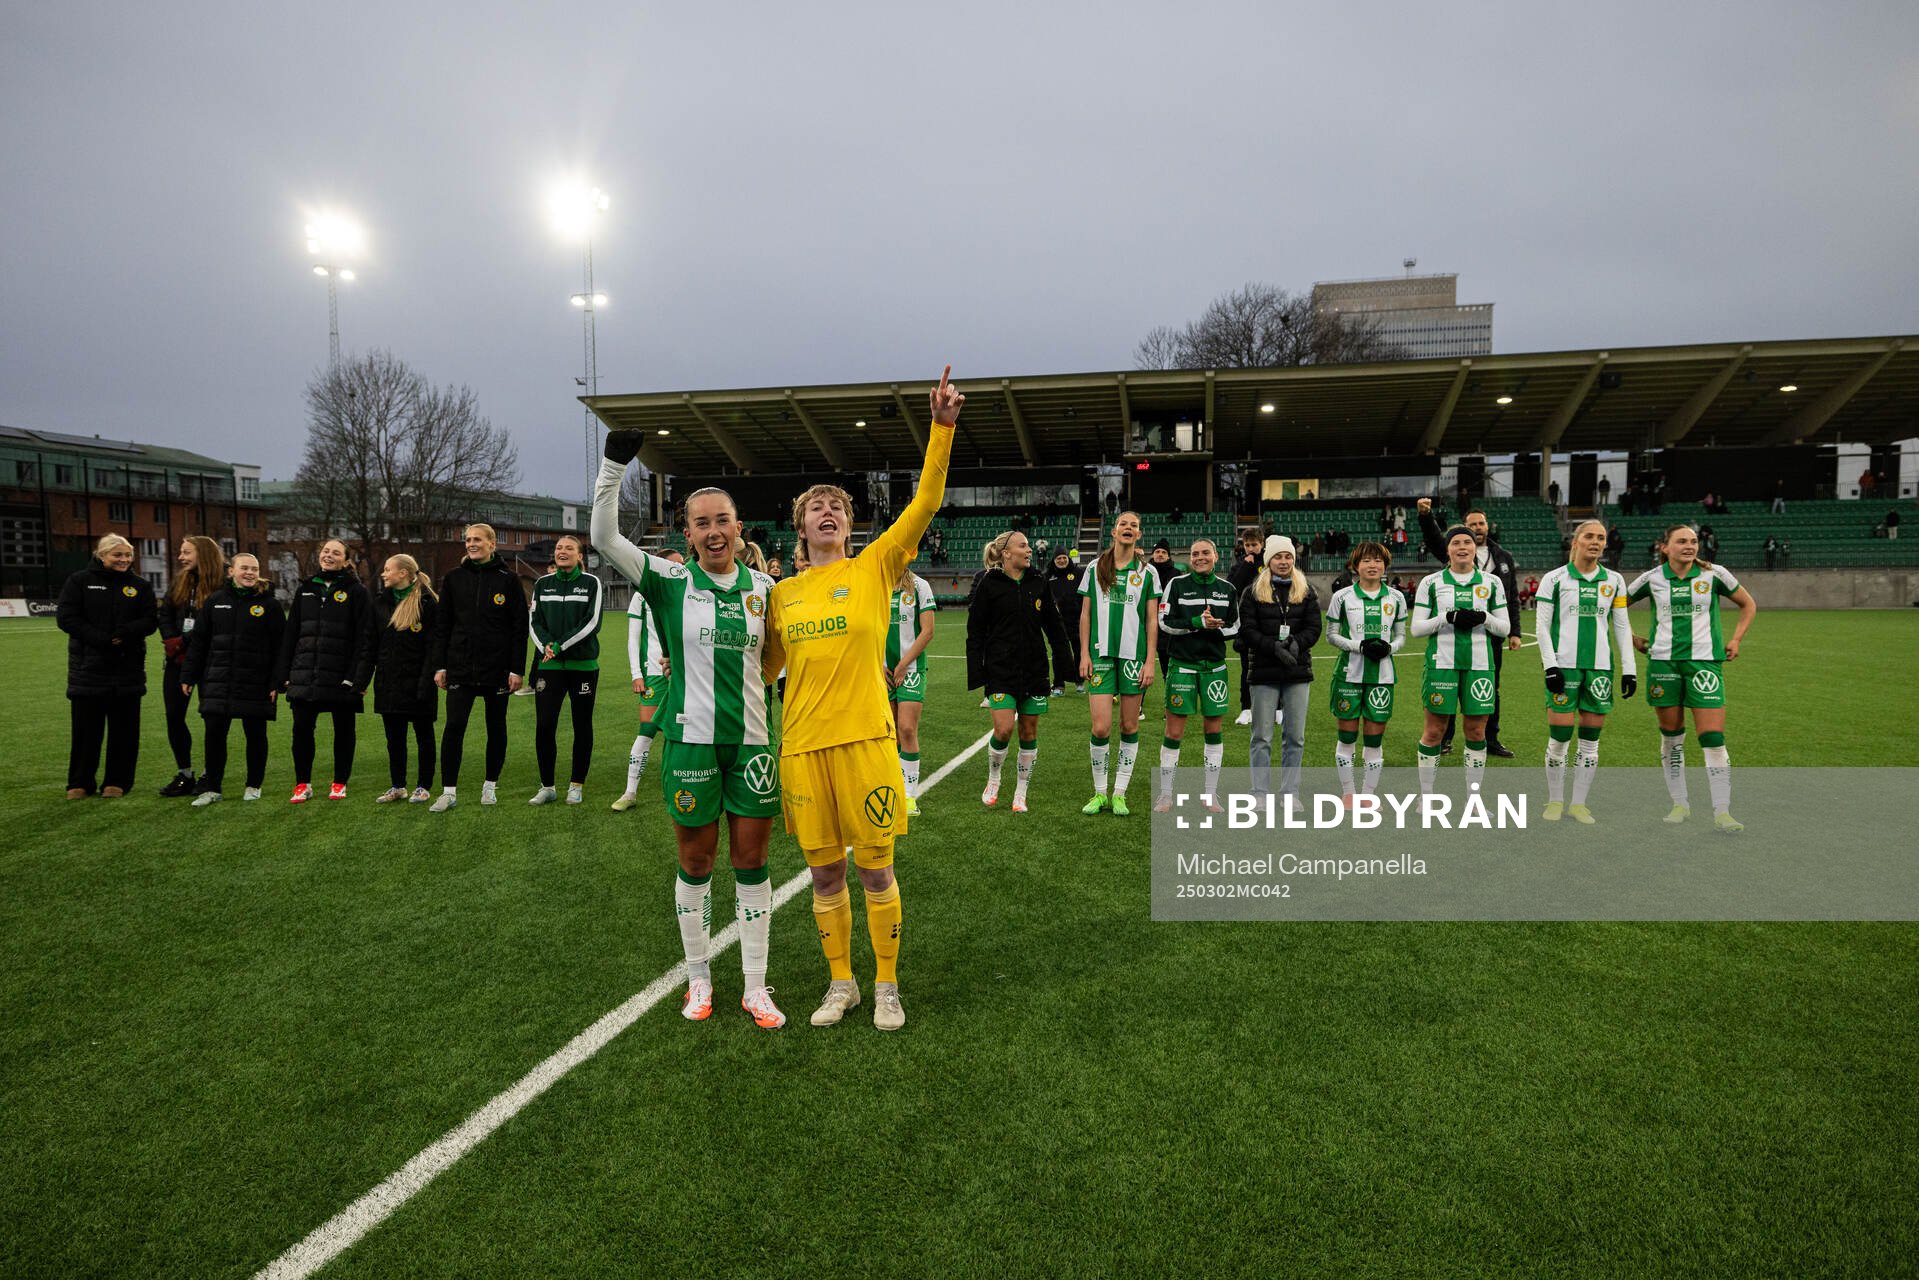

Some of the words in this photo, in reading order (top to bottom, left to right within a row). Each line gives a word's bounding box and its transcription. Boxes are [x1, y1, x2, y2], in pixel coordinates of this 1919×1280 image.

[787, 616, 847, 639] PROJOB
[699, 627, 759, 647] PROJOB
[581, 682, 590, 691] 15
[673, 767, 718, 777] BOSPHORUS
